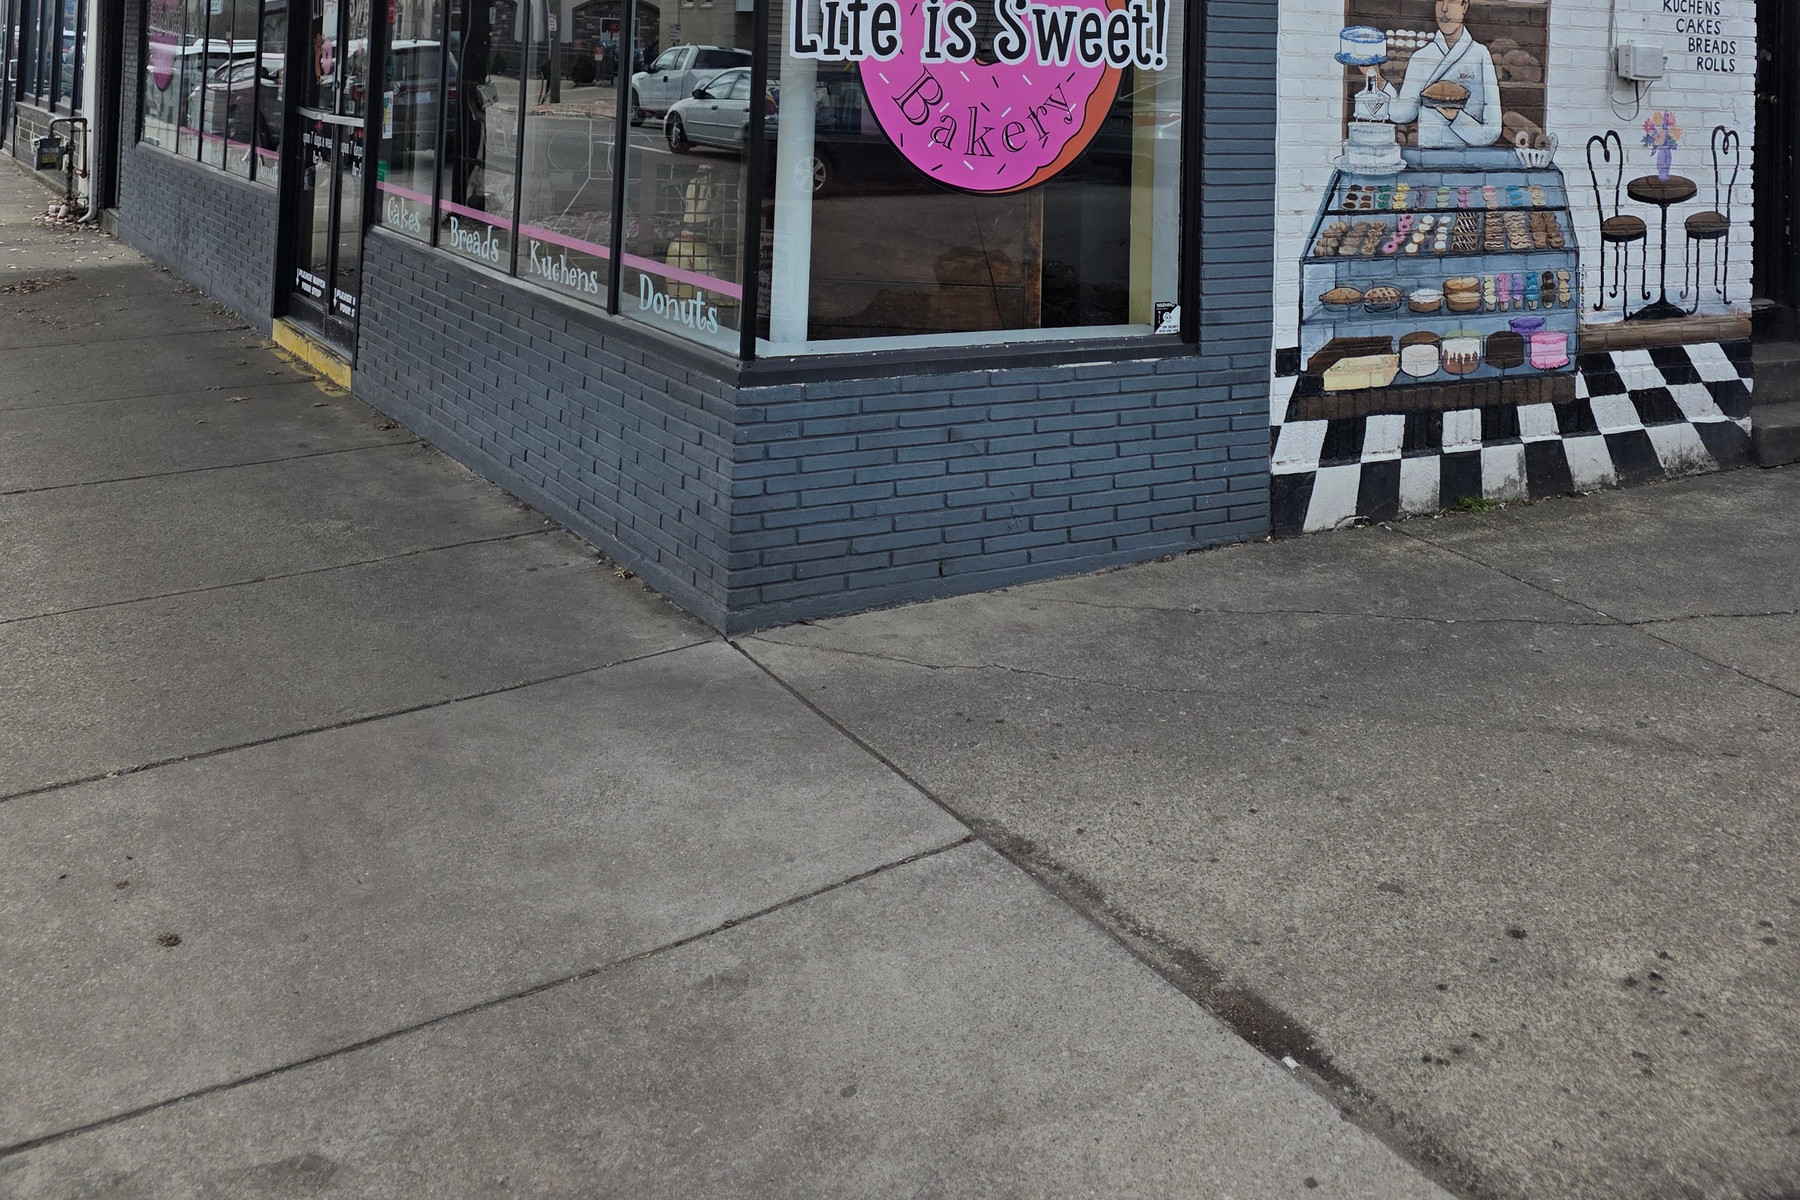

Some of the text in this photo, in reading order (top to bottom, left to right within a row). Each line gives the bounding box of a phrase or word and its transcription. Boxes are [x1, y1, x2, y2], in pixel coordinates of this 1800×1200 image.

[1676, 18, 1721, 35] CAKES
[1688, 37, 1736, 54] BREADS
[1697, 56, 1736, 72] ROLLS
[891, 65, 1076, 158] Bakery
[387, 197, 421, 233] Cakes
[450, 216, 499, 263] Breads
[529, 239, 599, 294] Kuchens
[638, 274, 719, 334] Donuts
